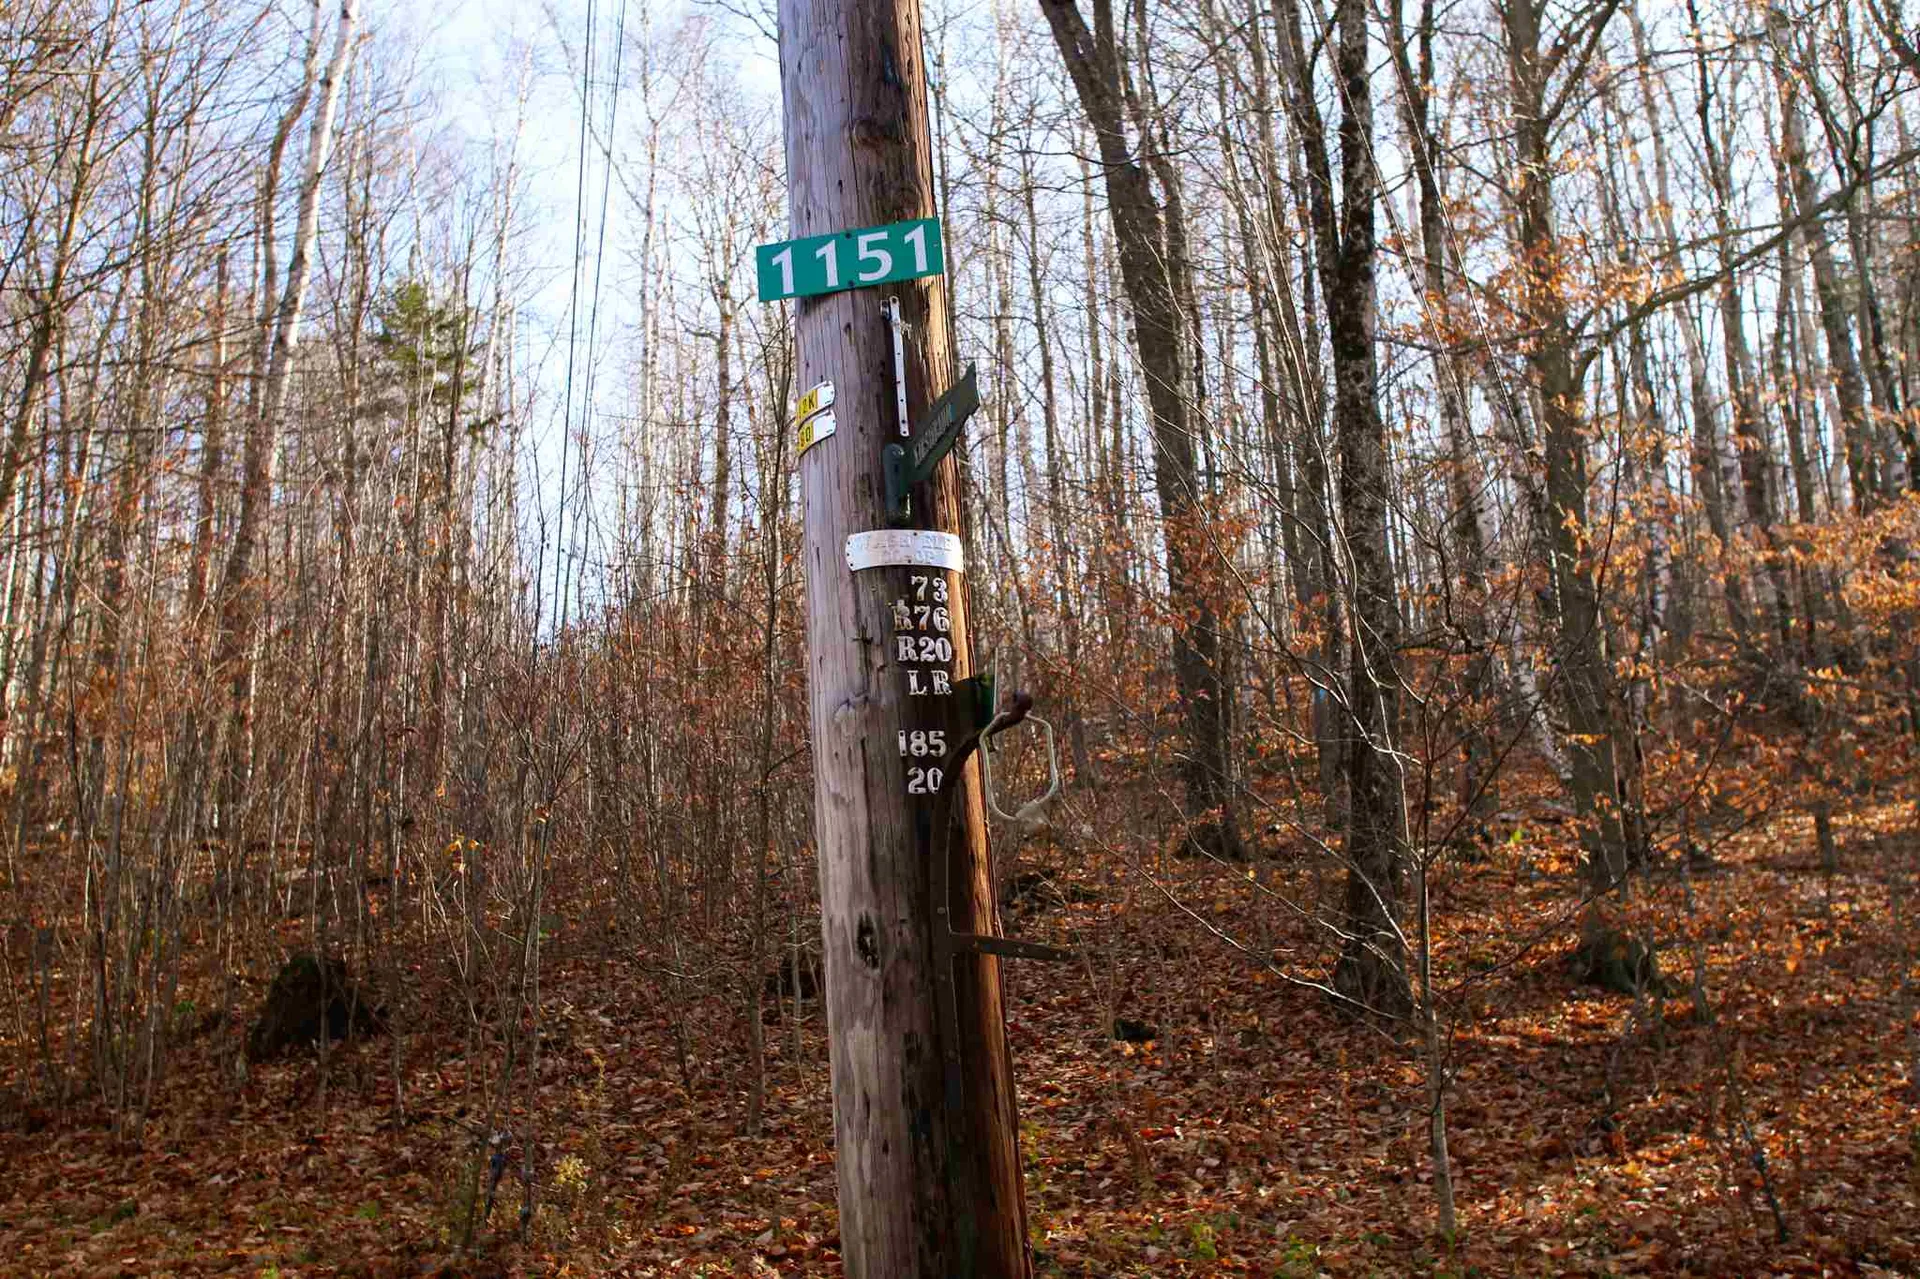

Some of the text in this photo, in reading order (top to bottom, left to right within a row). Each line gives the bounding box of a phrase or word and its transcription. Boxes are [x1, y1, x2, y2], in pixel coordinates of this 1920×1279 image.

[772, 224, 928, 294] 1151
[911, 575, 948, 602] 73
[896, 635, 952, 662] R20
[898, 730, 946, 757] 185
[907, 767, 943, 794] 20
